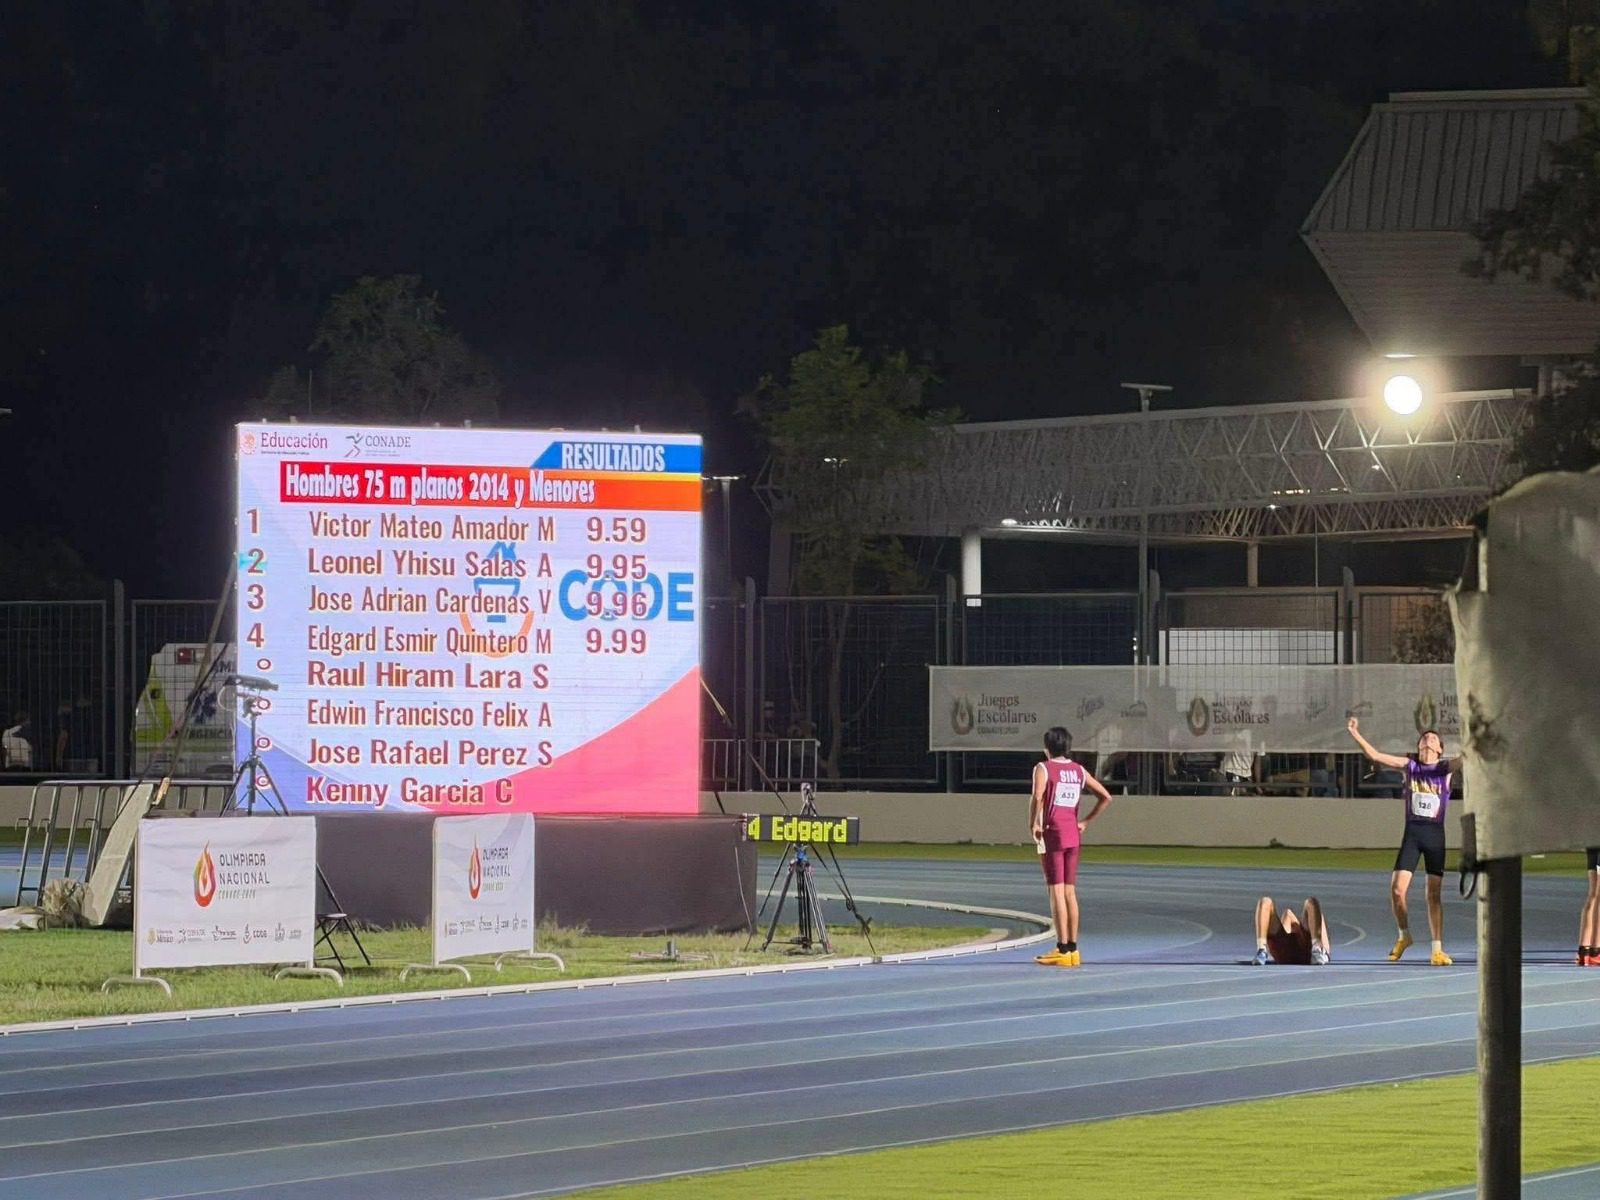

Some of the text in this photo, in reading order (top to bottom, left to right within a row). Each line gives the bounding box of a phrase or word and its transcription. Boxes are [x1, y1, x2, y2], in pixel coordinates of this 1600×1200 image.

[261, 432, 328, 449] Educación
[365, 435, 411, 448] CONADE
[562, 443, 666, 472] RESULTADOS
[286, 464, 595, 509] Hombres 75 m planos 2014 y Menores
[247, 509, 646, 543] 1 Victor Mateo Amador M 9.59
[247, 548, 647, 580] 2 Leonel Yhisu Salas A 9.95
[247, 584, 647, 617] 3 Jose Adrian Cardenas V 9.96
[559, 569, 694, 622] CODE
[247, 623, 646, 656] 4 Edgard Esmir Quintero M 9.99
[308, 660, 549, 689] Raul Hiram Lara S
[308, 699, 552, 727] Edwin Francisco Felix A
[308, 738, 553, 766] Jose Rafael Perez S
[307, 776, 512, 807] Kenny Garcia C
[748, 816, 848, 843] 4 Edgard
[220, 853, 266, 866] OLIMPIADA
[219, 872, 270, 885] NACIONAL
